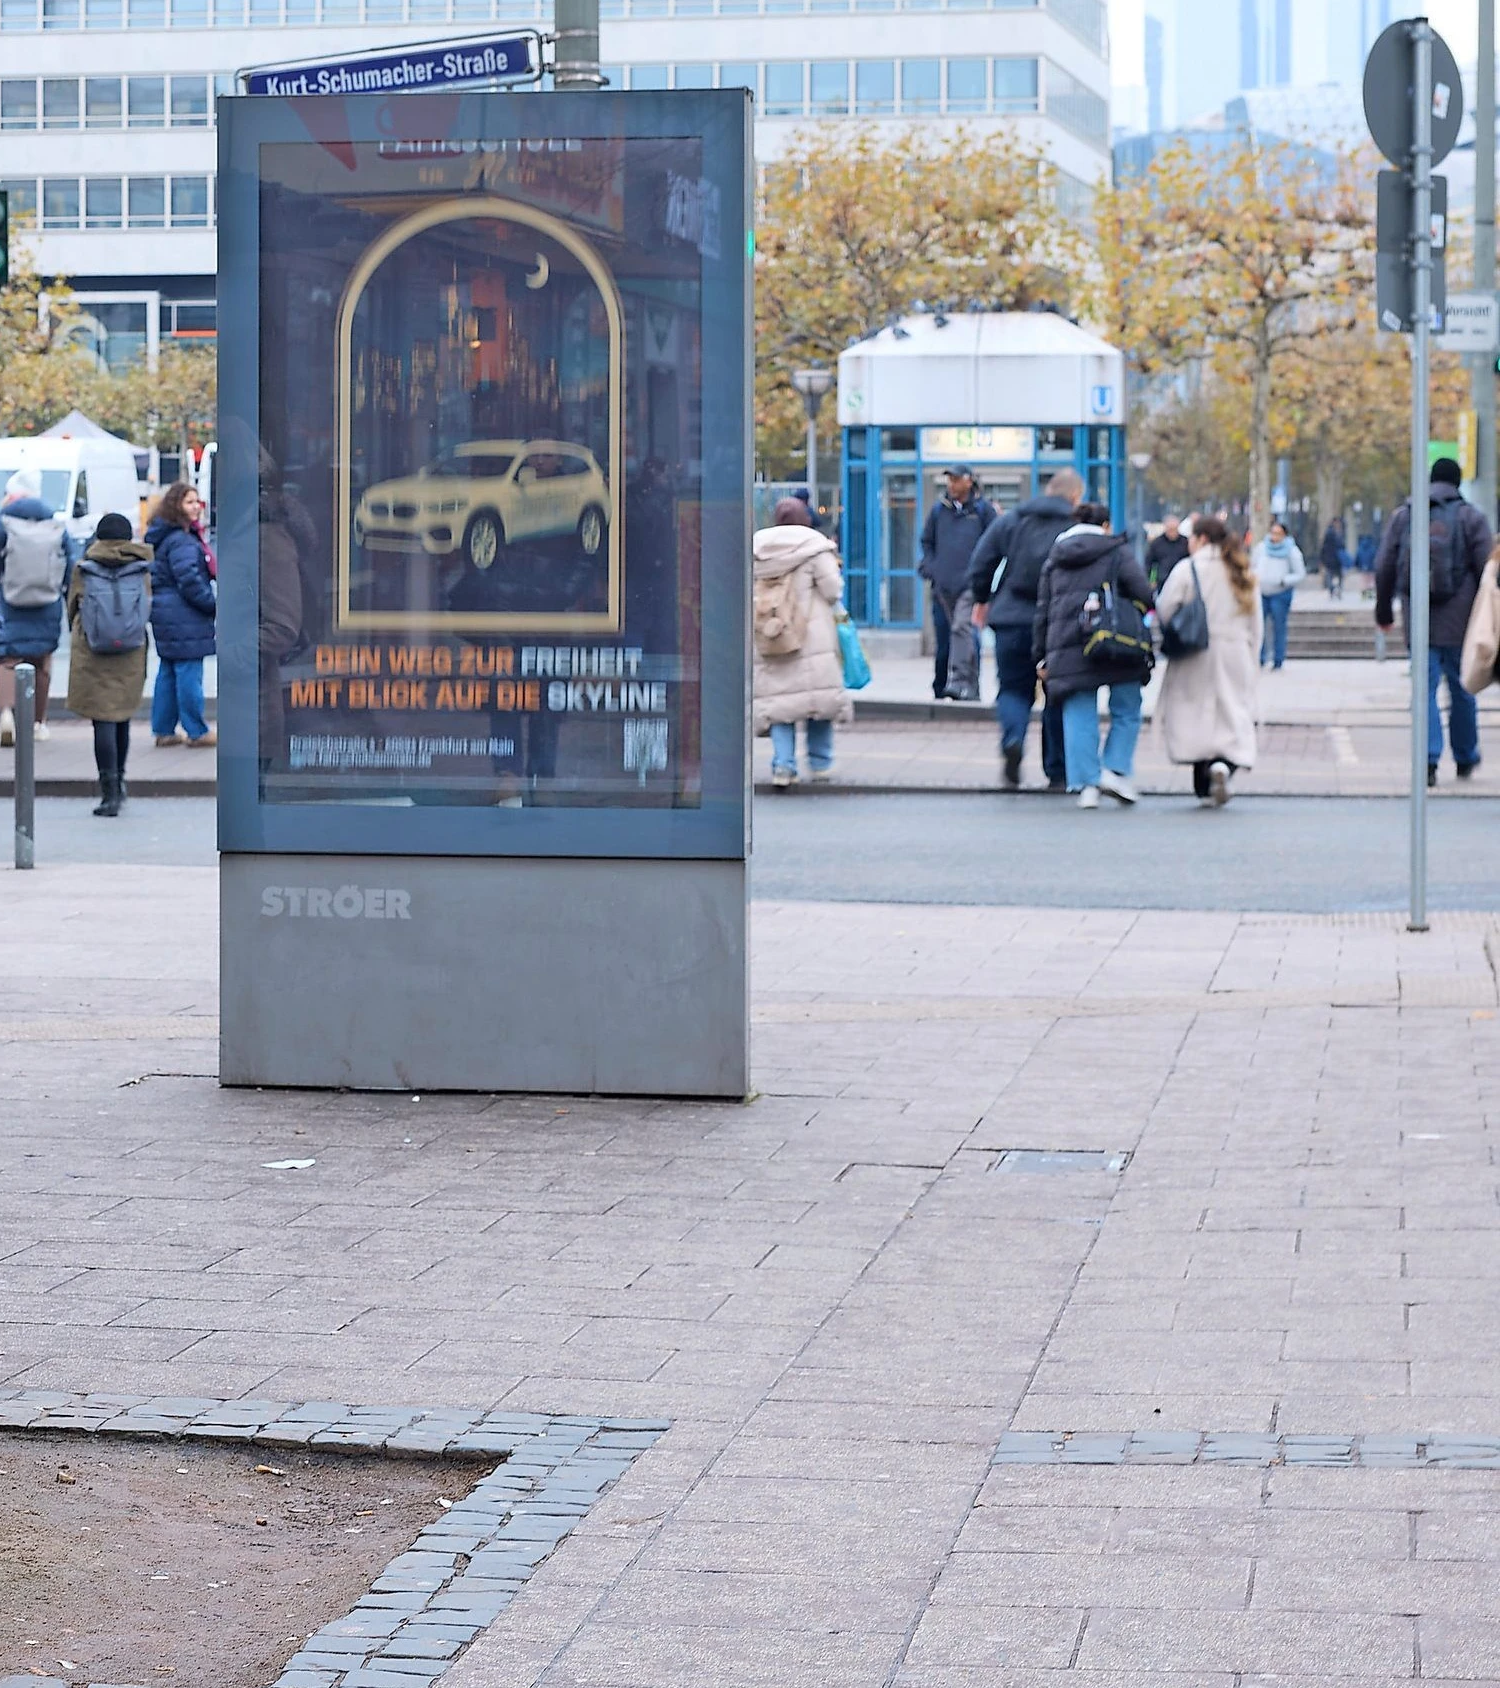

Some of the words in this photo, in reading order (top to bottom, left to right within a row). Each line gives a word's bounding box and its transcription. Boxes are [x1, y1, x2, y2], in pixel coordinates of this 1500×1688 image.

[266, 48, 508, 95] Kurt-Schumacher-Straße
[316, 645, 381, 675] DEIN
[389, 645, 452, 676] WEG
[459, 646, 514, 676] ZUR
[521, 646, 643, 677] FREIHEIT
[290, 680, 342, 709] MIT
[348, 680, 427, 710] BLICK
[435, 680, 490, 711] AUF
[496, 680, 540, 711] DIE
[547, 681, 667, 713] SKYLINE
[261, 885, 412, 919] STRÖER
